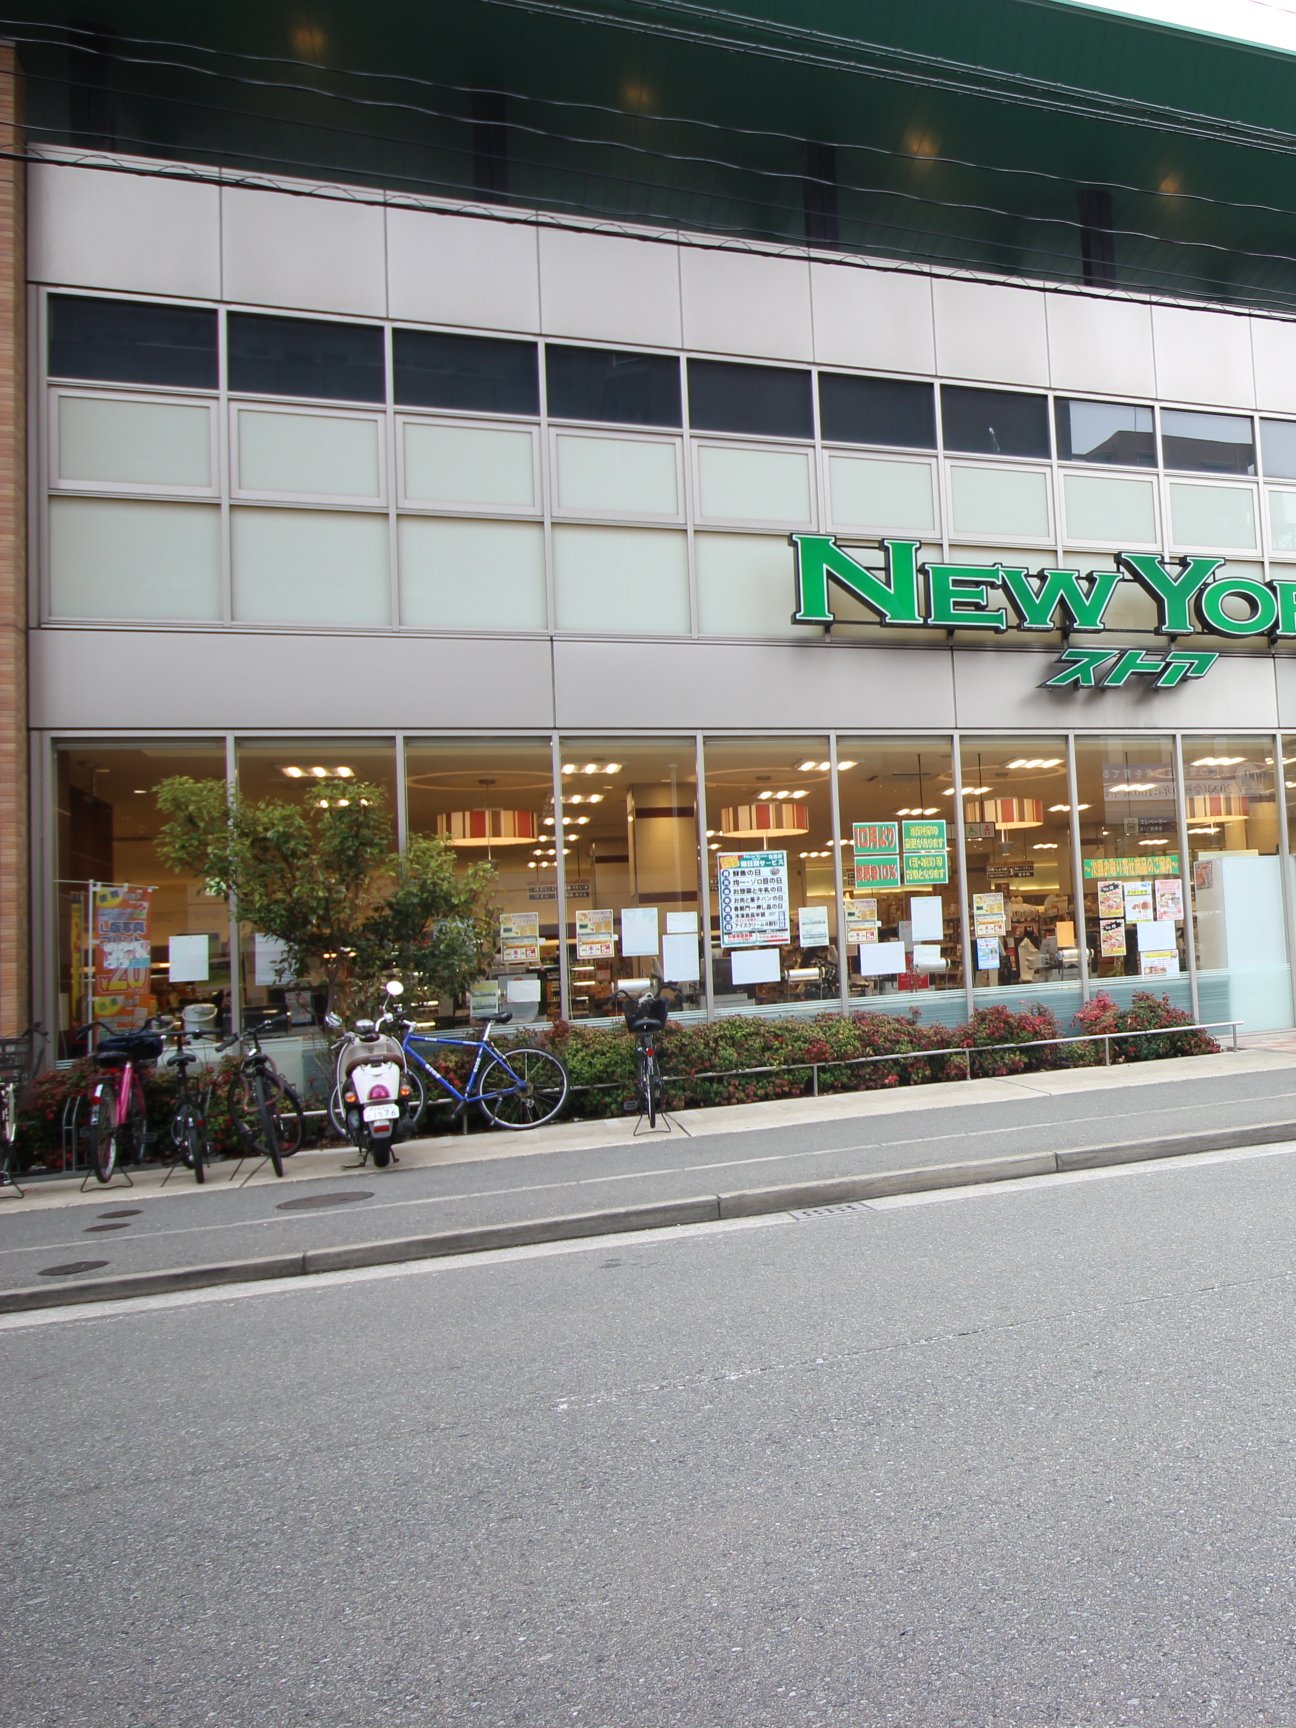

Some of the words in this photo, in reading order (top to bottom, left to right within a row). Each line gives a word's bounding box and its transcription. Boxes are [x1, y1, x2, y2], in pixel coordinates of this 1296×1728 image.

[791, 533, 1122, 629] NEW
[1040, 648, 1222, 689] ストア
